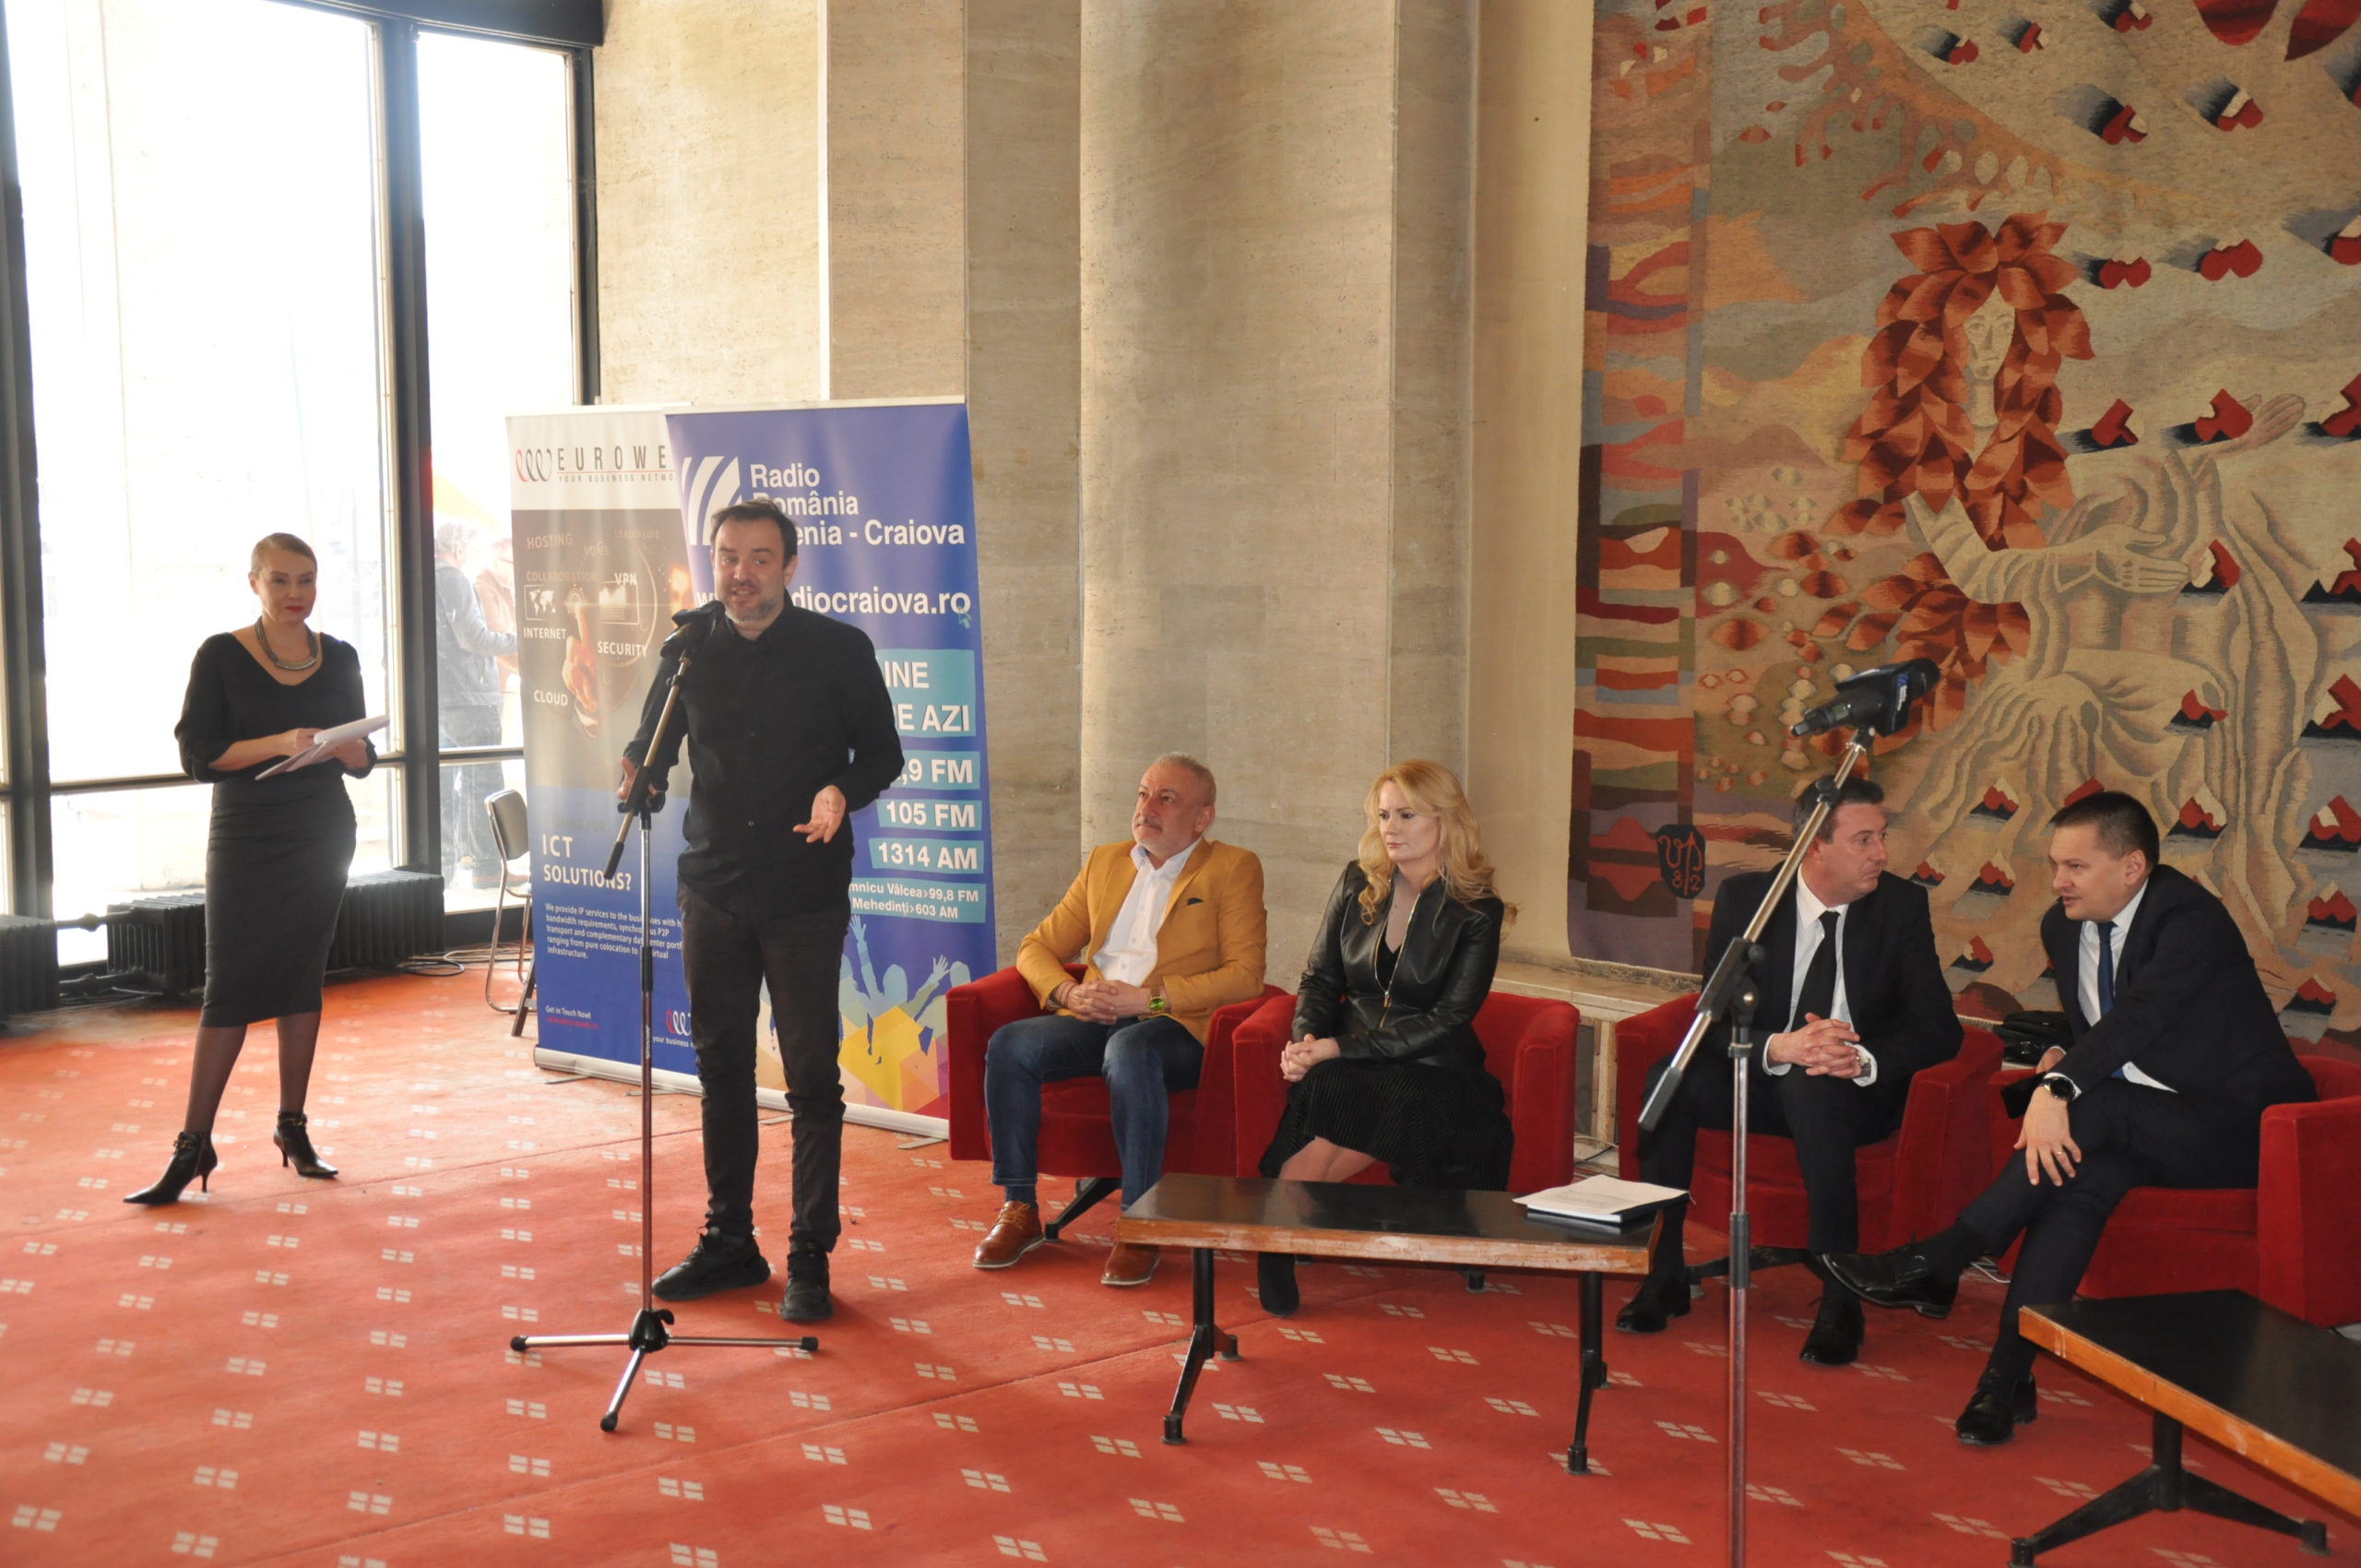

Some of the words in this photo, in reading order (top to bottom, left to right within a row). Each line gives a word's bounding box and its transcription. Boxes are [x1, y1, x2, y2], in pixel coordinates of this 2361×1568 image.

[557, 445, 667, 471] EUROWE
[558, 473, 582, 483] YOUR
[588, 473, 635, 482] BUSINESS
[641, 473, 674, 482] NETWO
[750, 462, 821, 489] Radio
[527, 532, 574, 550] HOSTING
[796, 520, 842, 546] enia
[864, 518, 966, 546] Craiova
[527, 571, 598, 583] COLLABORATION
[614, 573, 637, 586] VPN
[696, 587, 971, 615] wdiocraiova.ro
[523, 627, 566, 640] INTERNET
[598, 640, 647, 657] SECURITY
[884, 660, 930, 689] INE
[533, 690, 568, 707] CLOUD
[896, 704, 915, 731] E
[921, 705, 969, 731] AZI
[896, 758, 922, 785] ,9
[931, 759, 973, 783] FM
[886, 801, 927, 826] 105
[934, 803, 975, 827] FM
[542, 834, 573, 858] ICT
[878, 841, 931, 867] 1314
[937, 847, 978, 870] AM
[543, 864, 633, 892] SOLUTIONS?
[848, 881, 884, 894] mnicu
[957, 890, 979, 902] FM
[545, 903, 553, 911] We
[555, 905, 577, 915] provide
[585, 909, 609, 919] services
[610, 911, 616, 920] to
[617, 911, 627, 921] the
[662, 918, 676, 927] with
[939, 907, 958, 919] AM
[546, 914, 577, 925] bandwidth
[577, 919, 617, 931] requirements,
[658, 928, 669, 937] P2P
[546, 925, 573, 936] transport
[574, 928, 586, 937] and
[586, 931, 632, 944] complementary
[666, 941, 682, 950] portf
[547, 936, 569, 947] ranging
[570, 937, 584, 946] from
[585, 941, 599, 950] pure
[599, 941, 630, 954] colocation
[631, 946, 638, 955] to
[652, 949, 669, 959] irtual
[545, 1004, 554, 1014] Get
[561, 1007, 576, 1016] Touch
[666, 1037, 689, 1048] business
